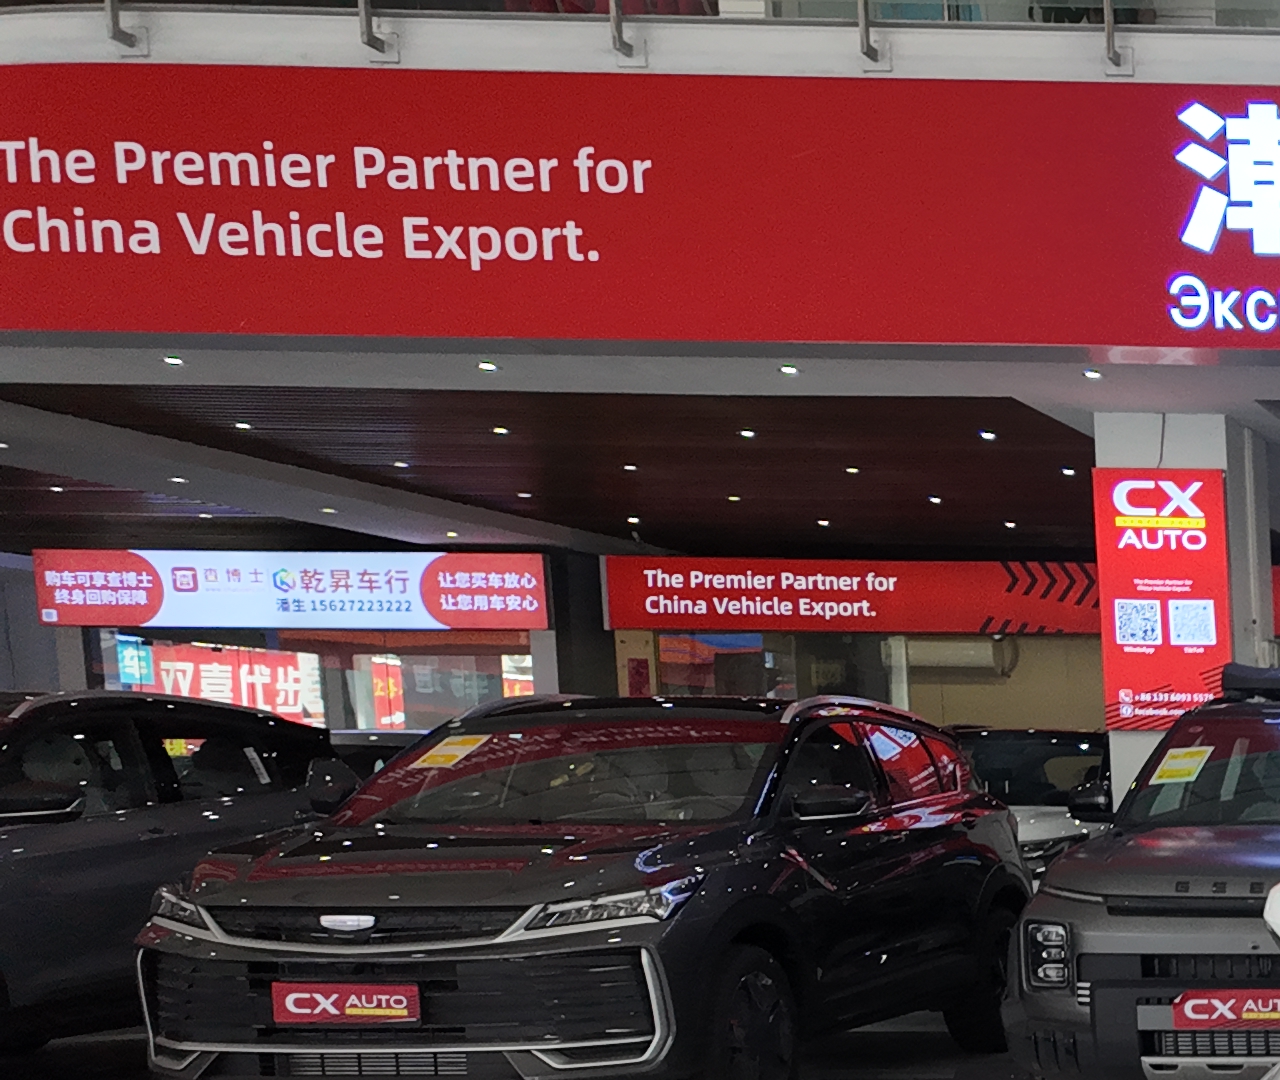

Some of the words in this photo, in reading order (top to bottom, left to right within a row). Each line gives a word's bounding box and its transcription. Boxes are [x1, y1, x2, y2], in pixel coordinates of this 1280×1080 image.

[0, 136, 96, 184] The
[114, 140, 336, 188] Premier
[353, 146, 559, 192] Partner
[573, 146, 652, 194] for
[2, 206, 161, 255] China
[176, 209, 384, 259] Vehicle
[402, 216, 600, 271] Export.
[1112, 480, 1206, 518] CX
[1118, 529, 1207, 551] AUTO
[643, 568, 684, 589] The
[689, 570, 776, 590] Premier
[780, 572, 861, 591] Partner
[865, 571, 898, 592] for
[645, 594, 707, 615] China
[712, 595, 793, 616] Vehicle
[798, 598, 877, 620] Export.
[285, 992, 340, 1015] CX
[345, 994, 408, 1011] AUTO
[1183, 998, 1237, 1020] CX
